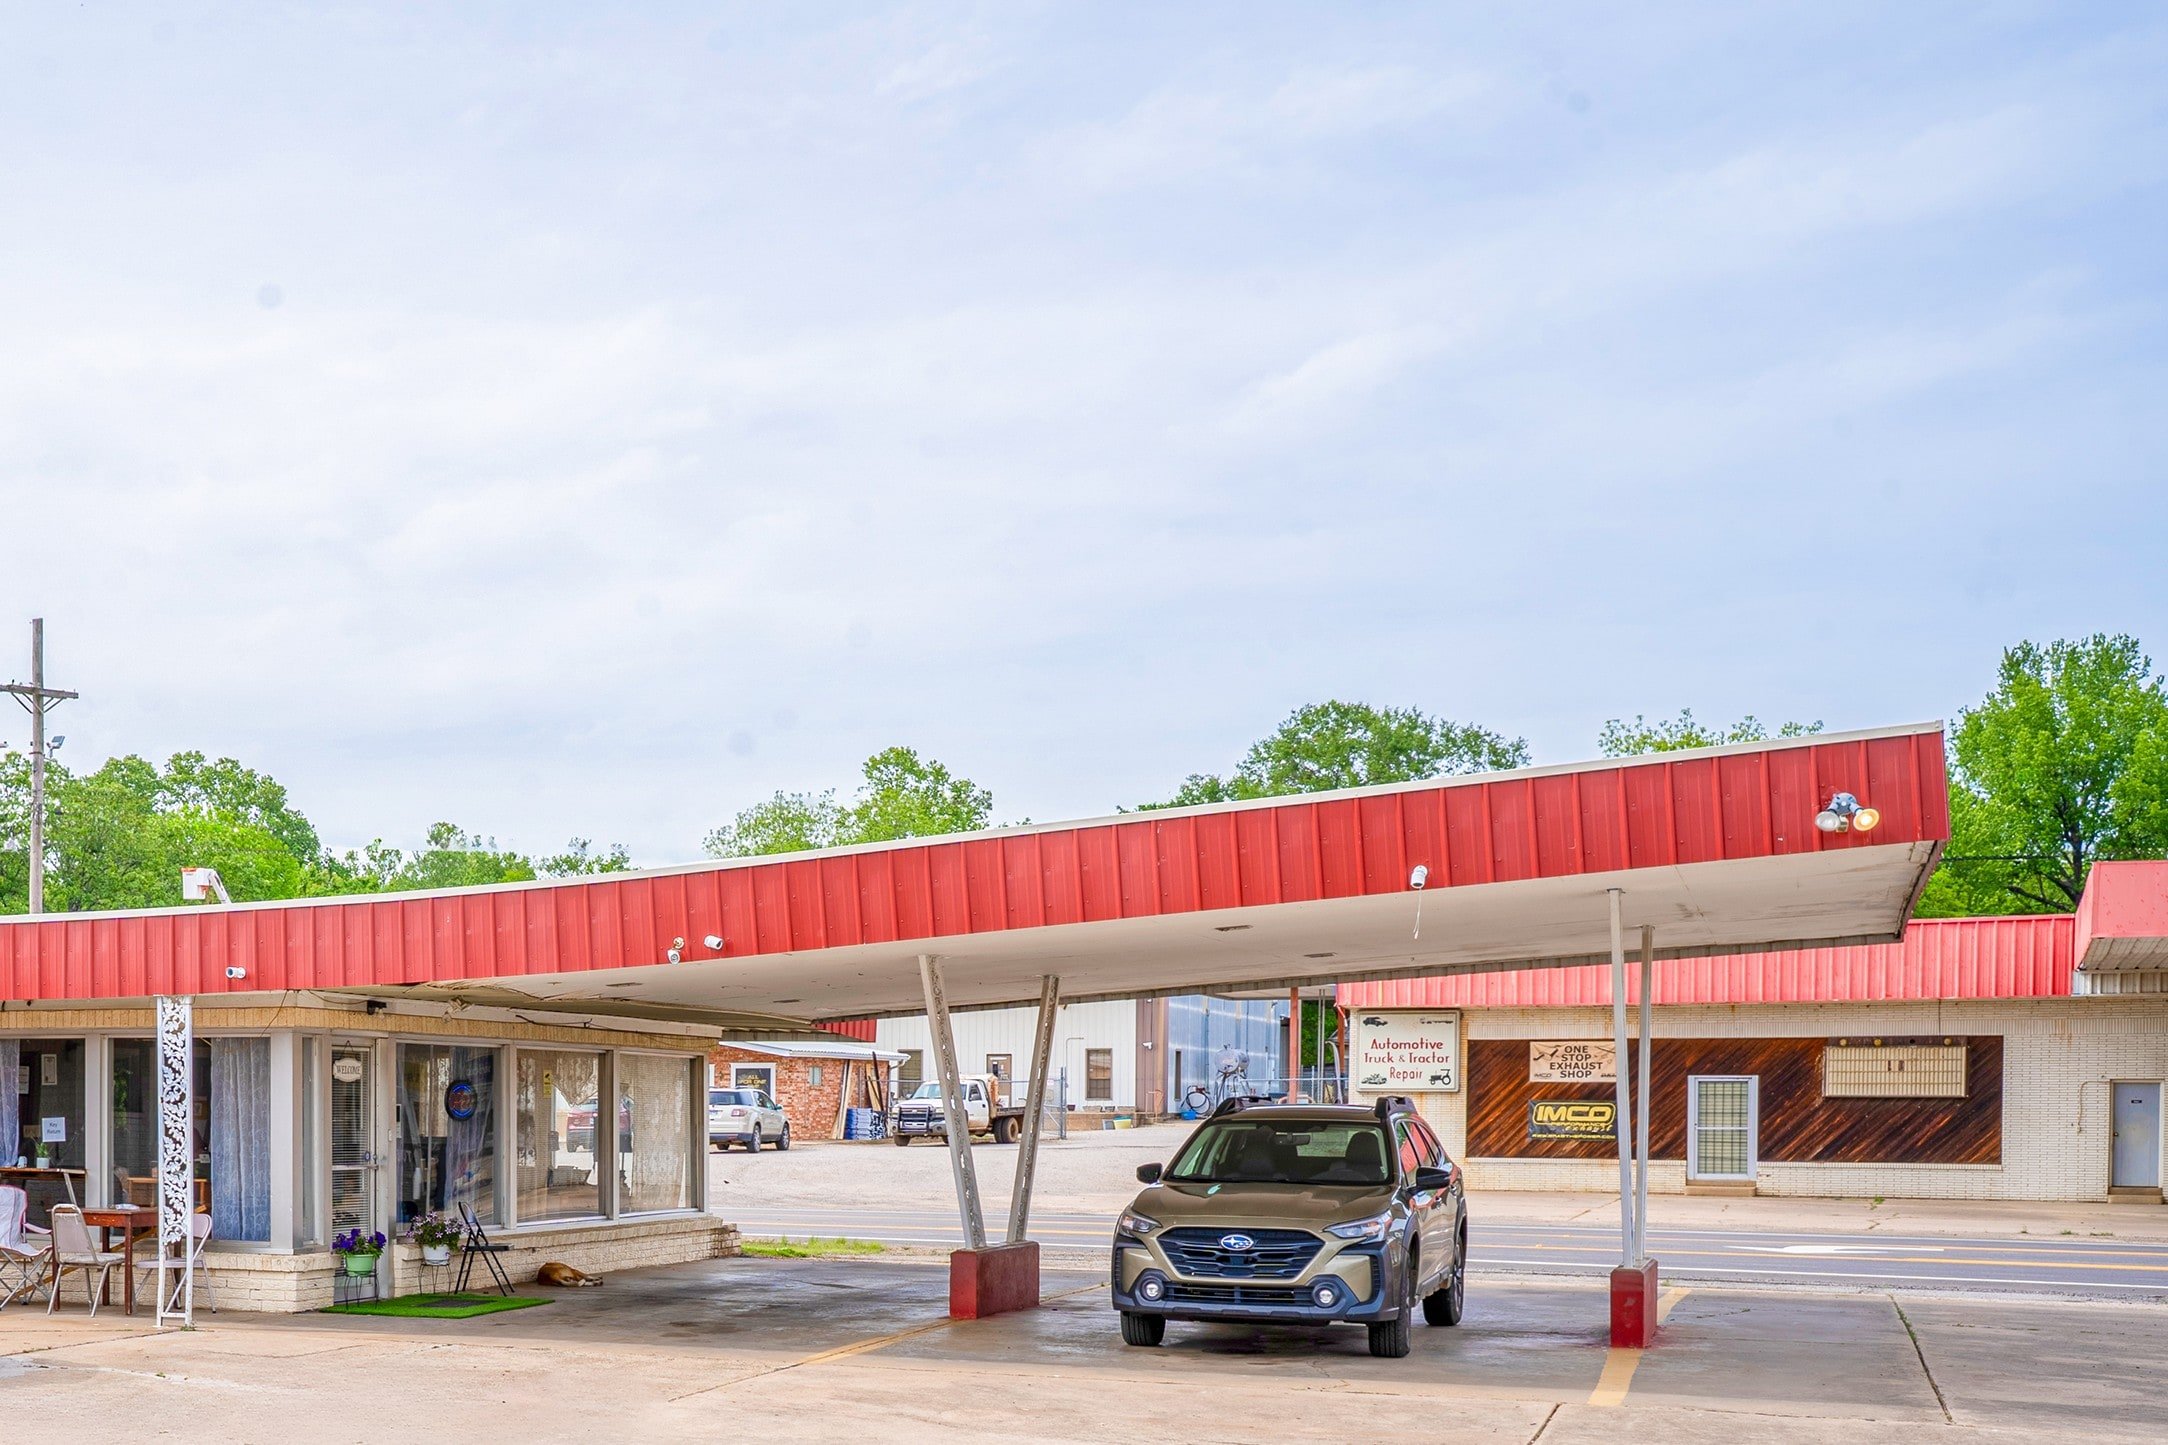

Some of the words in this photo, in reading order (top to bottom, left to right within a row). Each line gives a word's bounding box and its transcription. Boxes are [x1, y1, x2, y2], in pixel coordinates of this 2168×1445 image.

[1370, 1037, 1445, 1050] Automotive
[1564, 1045, 1589, 1054] ONE
[1364, 1052, 1394, 1063] Truck
[1398, 1055, 1405, 1063] &
[1409, 1052, 1450, 1063] Tractor
[1561, 1053, 1592, 1062] STOP
[336, 1065, 361, 1075] WELCOME
[1549, 1062, 1603, 1070] EXHAUST
[1389, 1066, 1423, 1082] Repair
[1560, 1070, 1592, 1079] SHOP
[1536, 1105, 1612, 1121] IMCO
